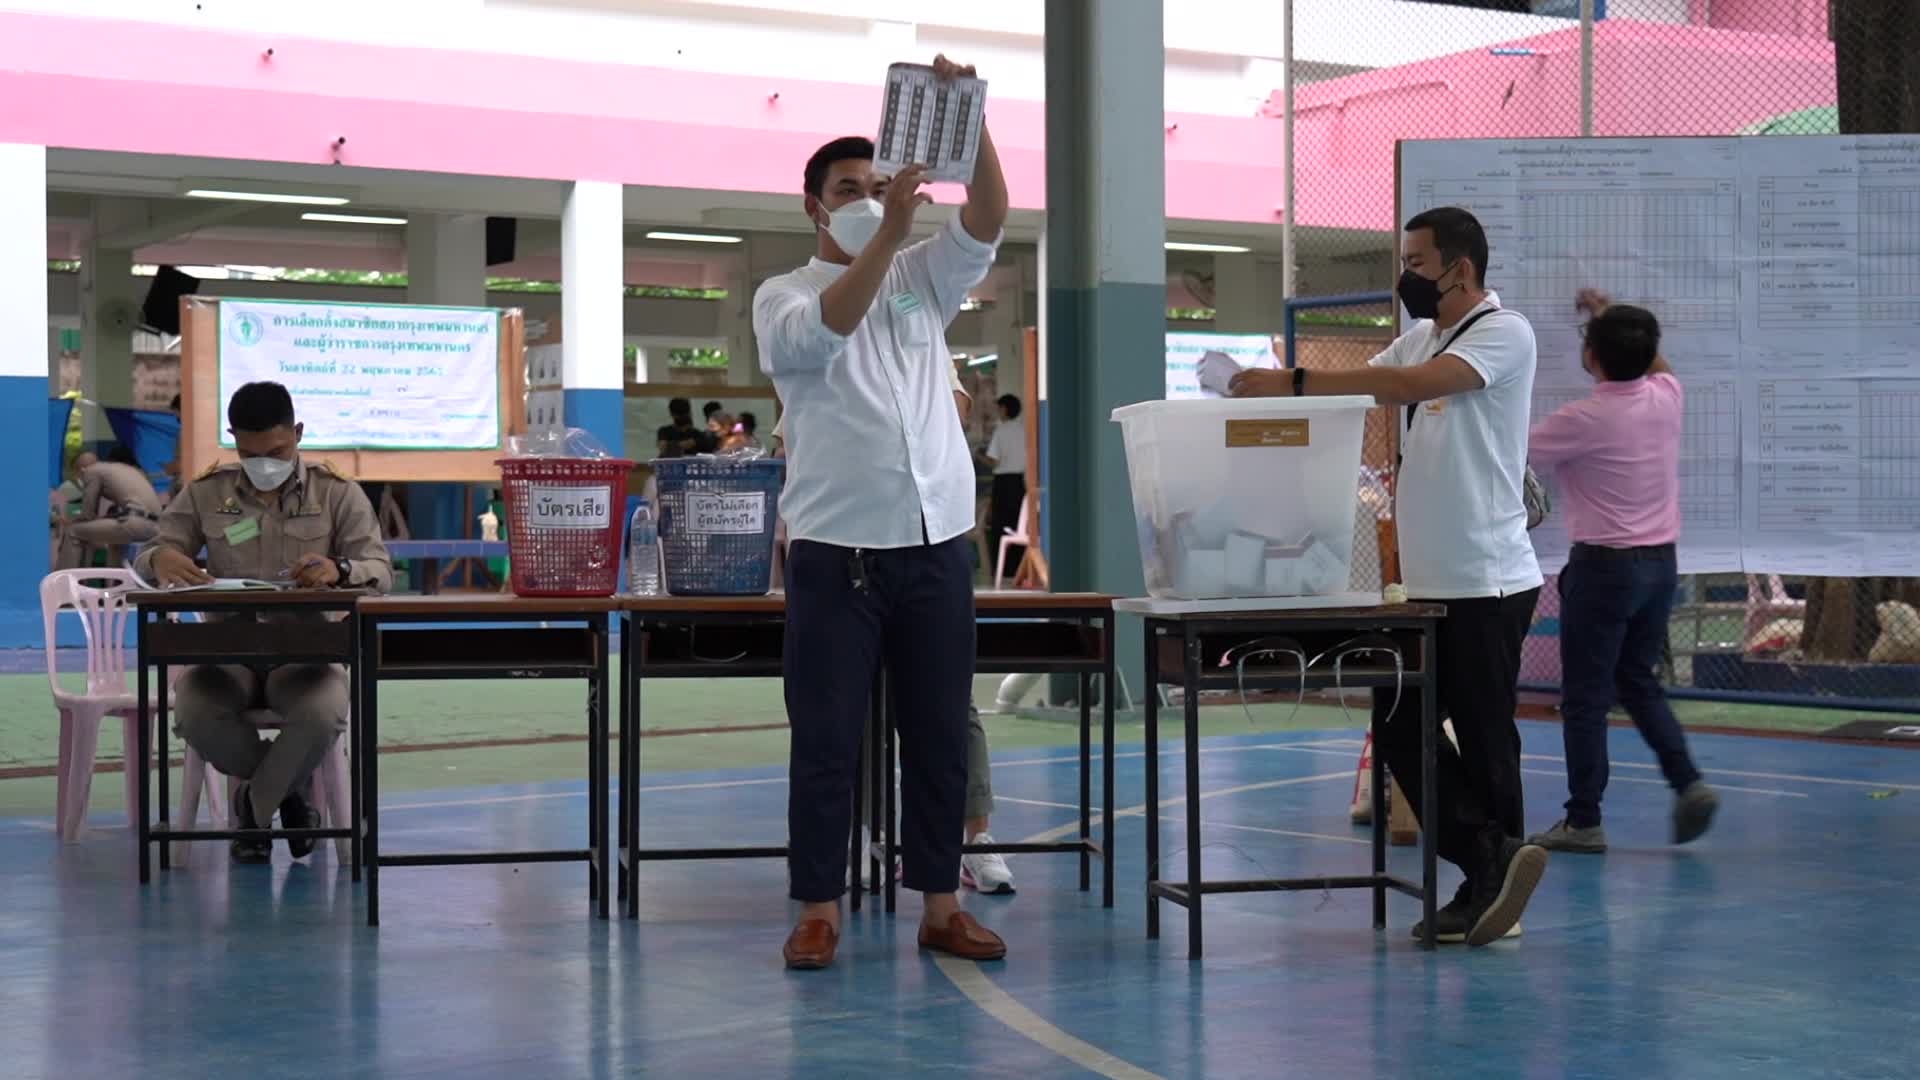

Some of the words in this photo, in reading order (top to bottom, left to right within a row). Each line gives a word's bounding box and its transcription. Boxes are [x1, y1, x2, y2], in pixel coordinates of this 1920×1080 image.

[294, 333, 471, 355] และผู้ว่าราชการกรุงเทพมหานคร
[536, 496, 606, 518] บัตรเสีย
[695, 498, 759, 511] บัตรไม่เลือก
[696, 512, 756, 528] ผู้สมัครผู้ใด
